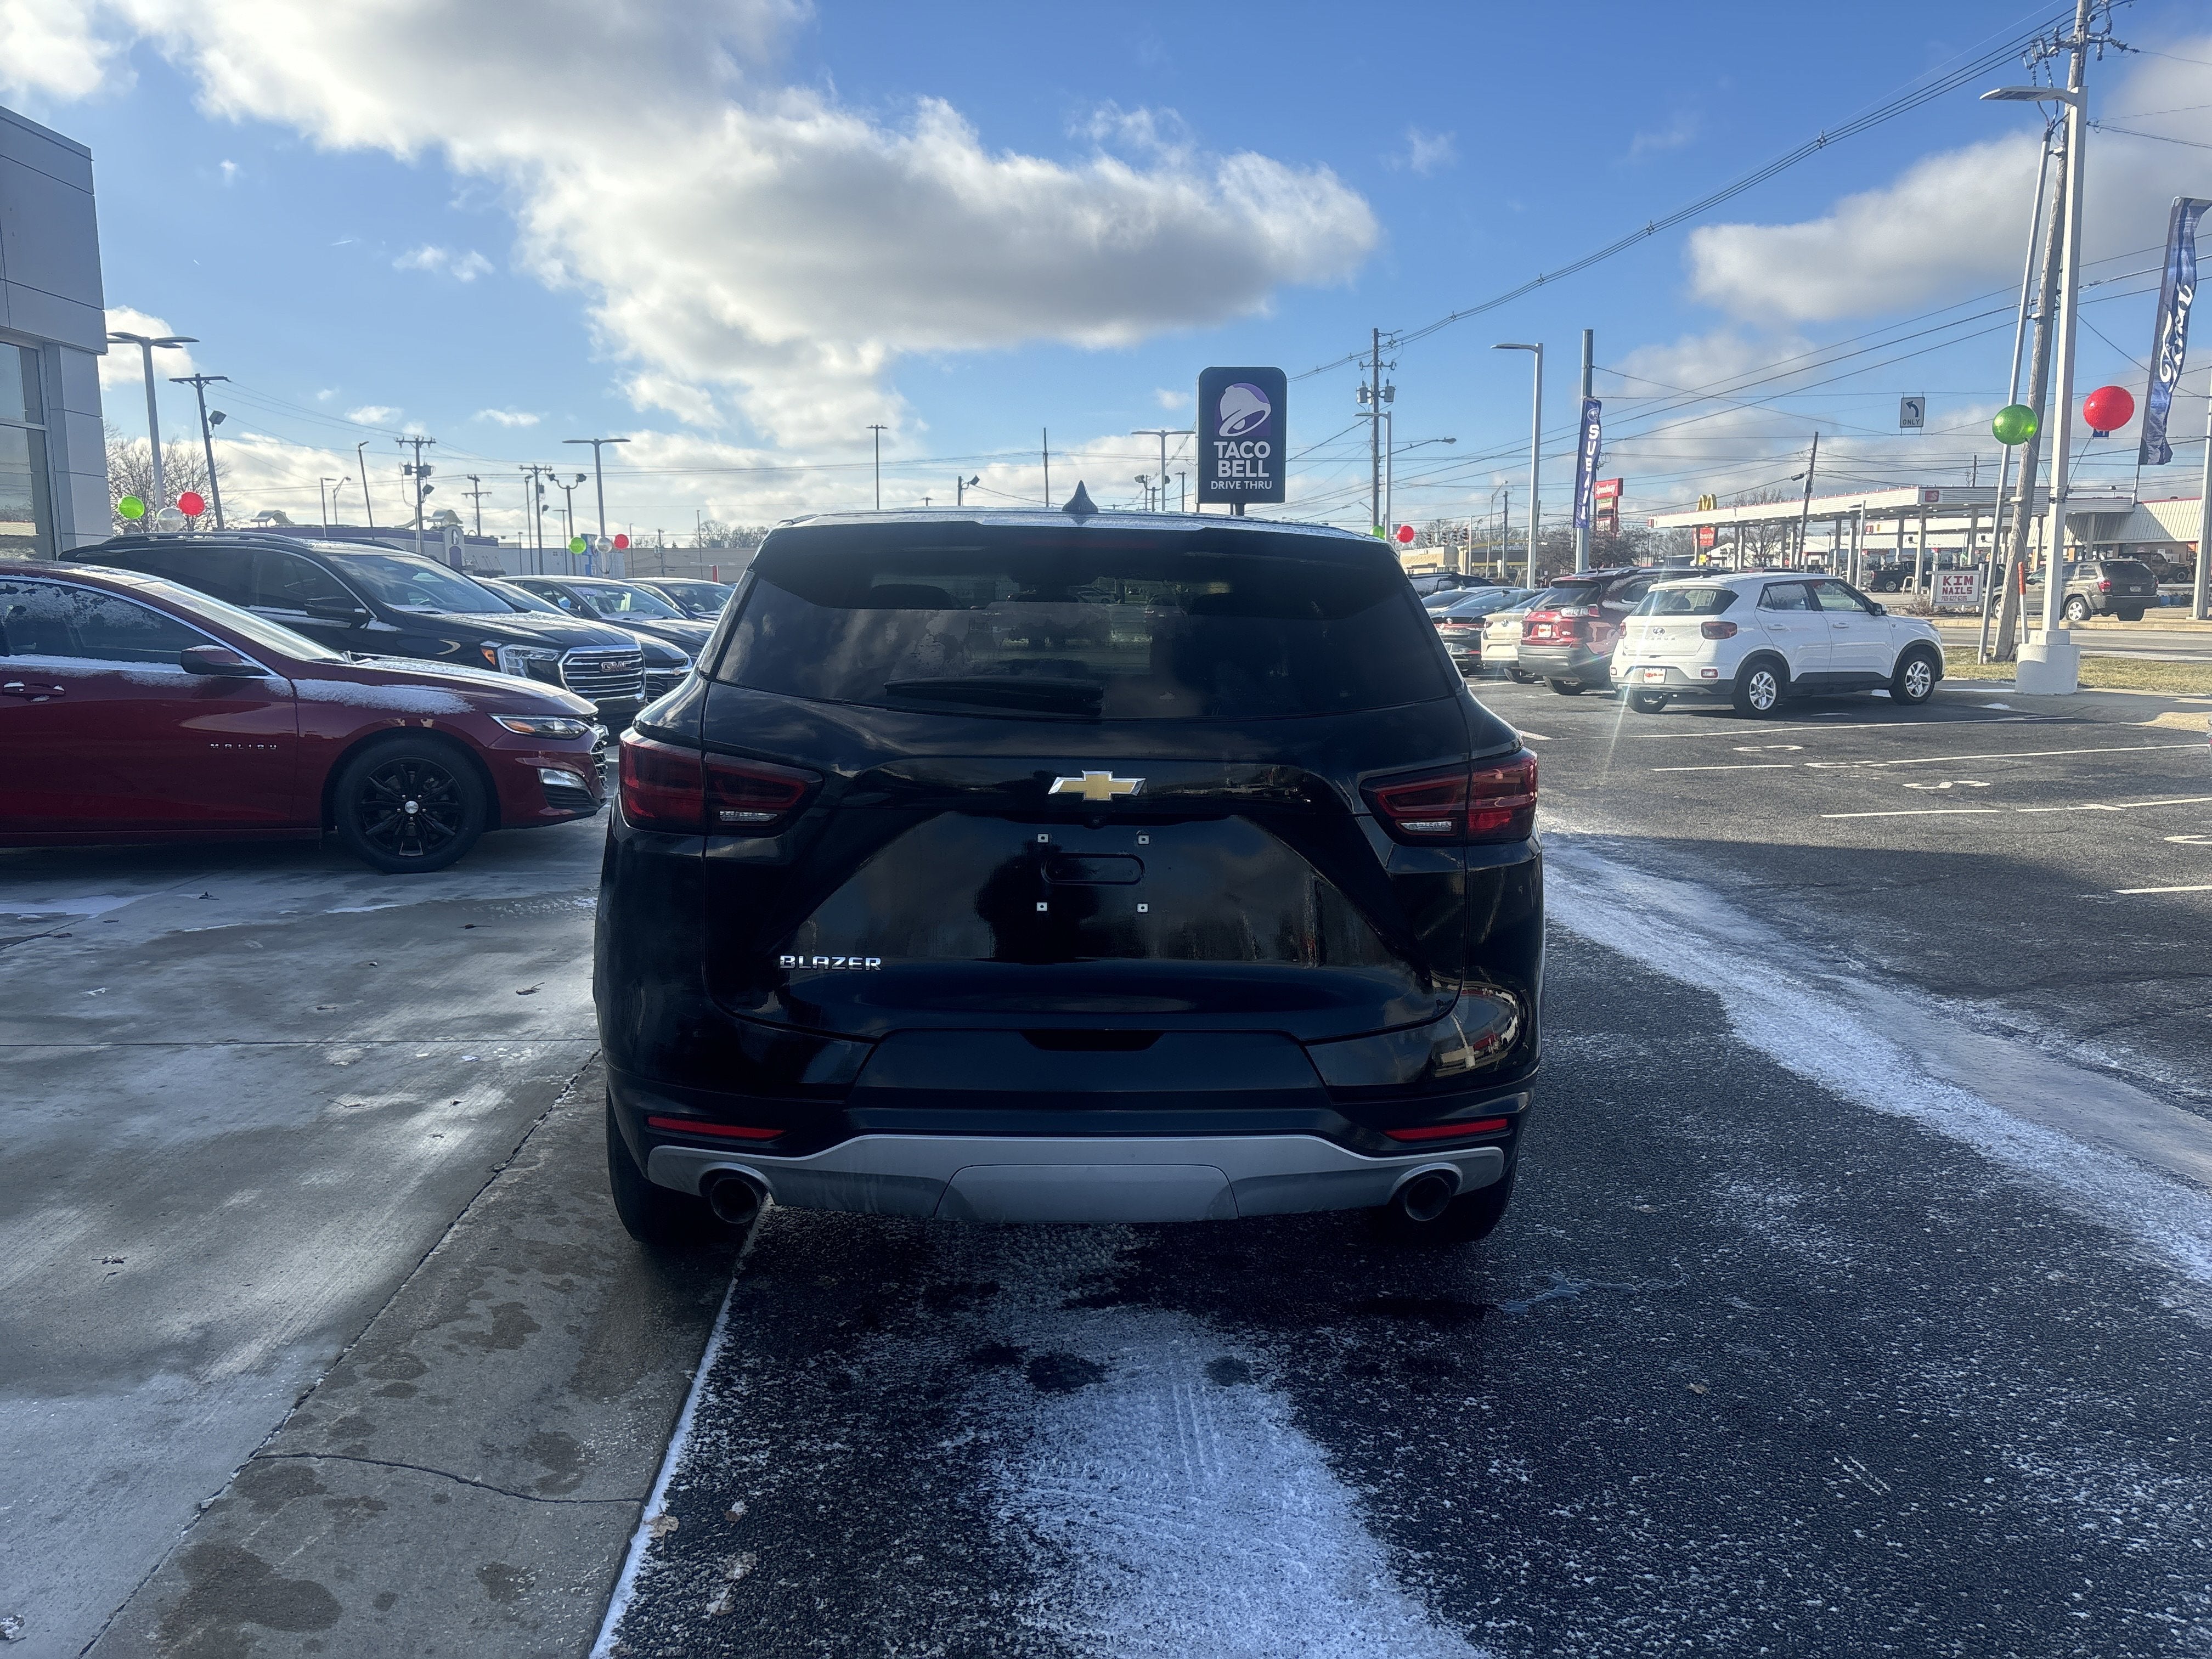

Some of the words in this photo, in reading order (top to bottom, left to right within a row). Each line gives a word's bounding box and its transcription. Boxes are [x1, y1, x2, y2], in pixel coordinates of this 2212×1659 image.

[1214, 441, 1271, 459] TACO
[1217, 460, 1269, 477] BELL
[1211, 481, 1242, 490] DRIVE
[1244, 481, 1272, 489] THRU
[1943, 575, 1973, 586] KIM
[1942, 586, 1973, 595] NAILS
[601, 661, 632, 673] GMC
[780, 955, 882, 970] BLAZER
